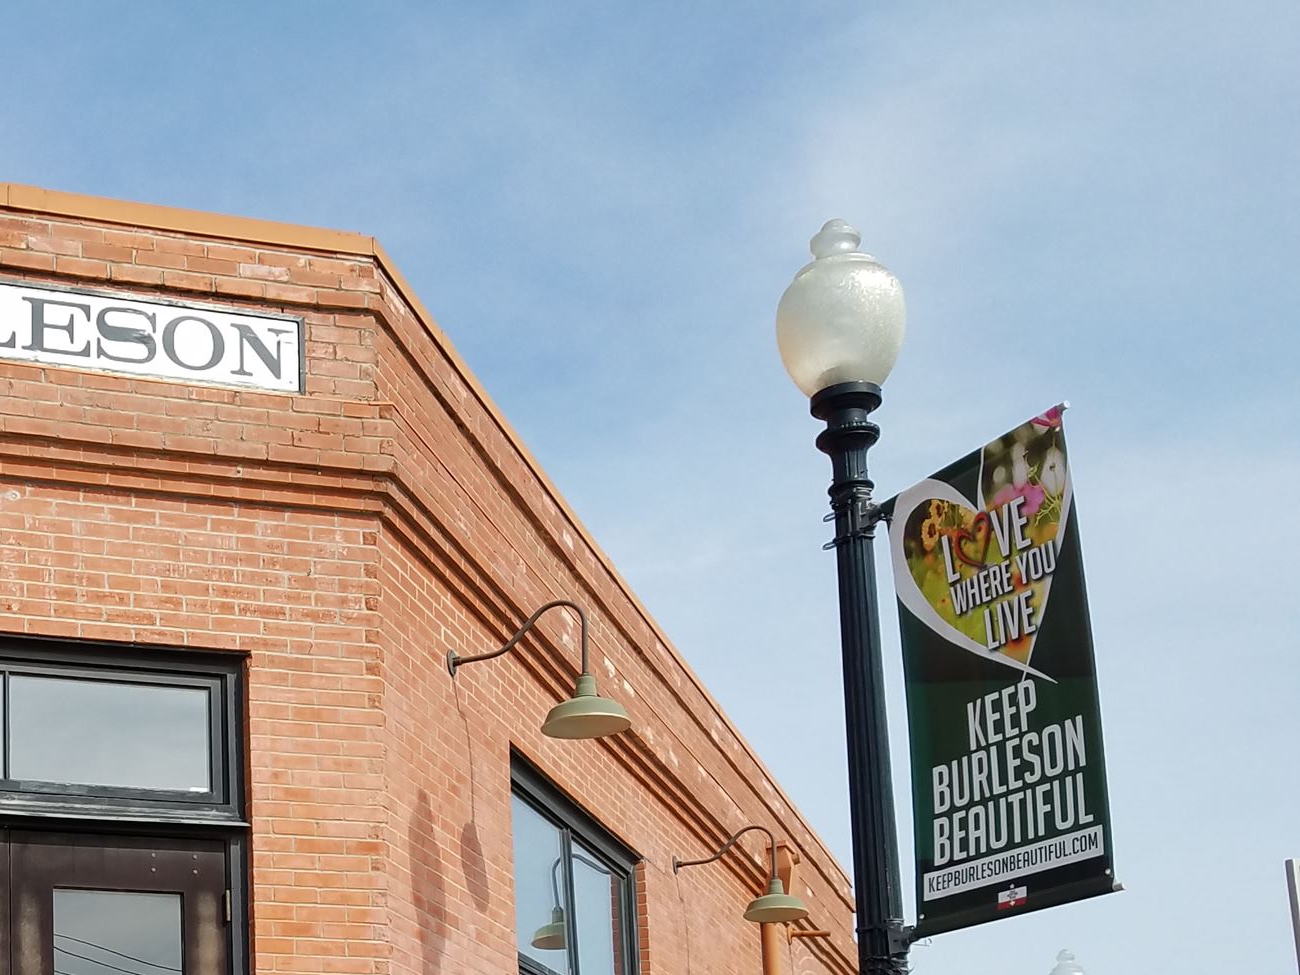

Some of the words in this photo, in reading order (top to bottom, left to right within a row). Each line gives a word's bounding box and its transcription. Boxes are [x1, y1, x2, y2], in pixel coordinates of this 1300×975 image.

[950, 557, 1014, 616] WHERE
[1015, 540, 1057, 585] YOU
[984, 591, 1036, 650] LIVE
[966, 679, 1037, 751] KEEP
[932, 714, 1087, 815] BURLESON
[933, 772, 1095, 867] BEAUTIFUL
[928, 831, 1099, 893] KEEPBURLESONBEAUTIFUL.COM
